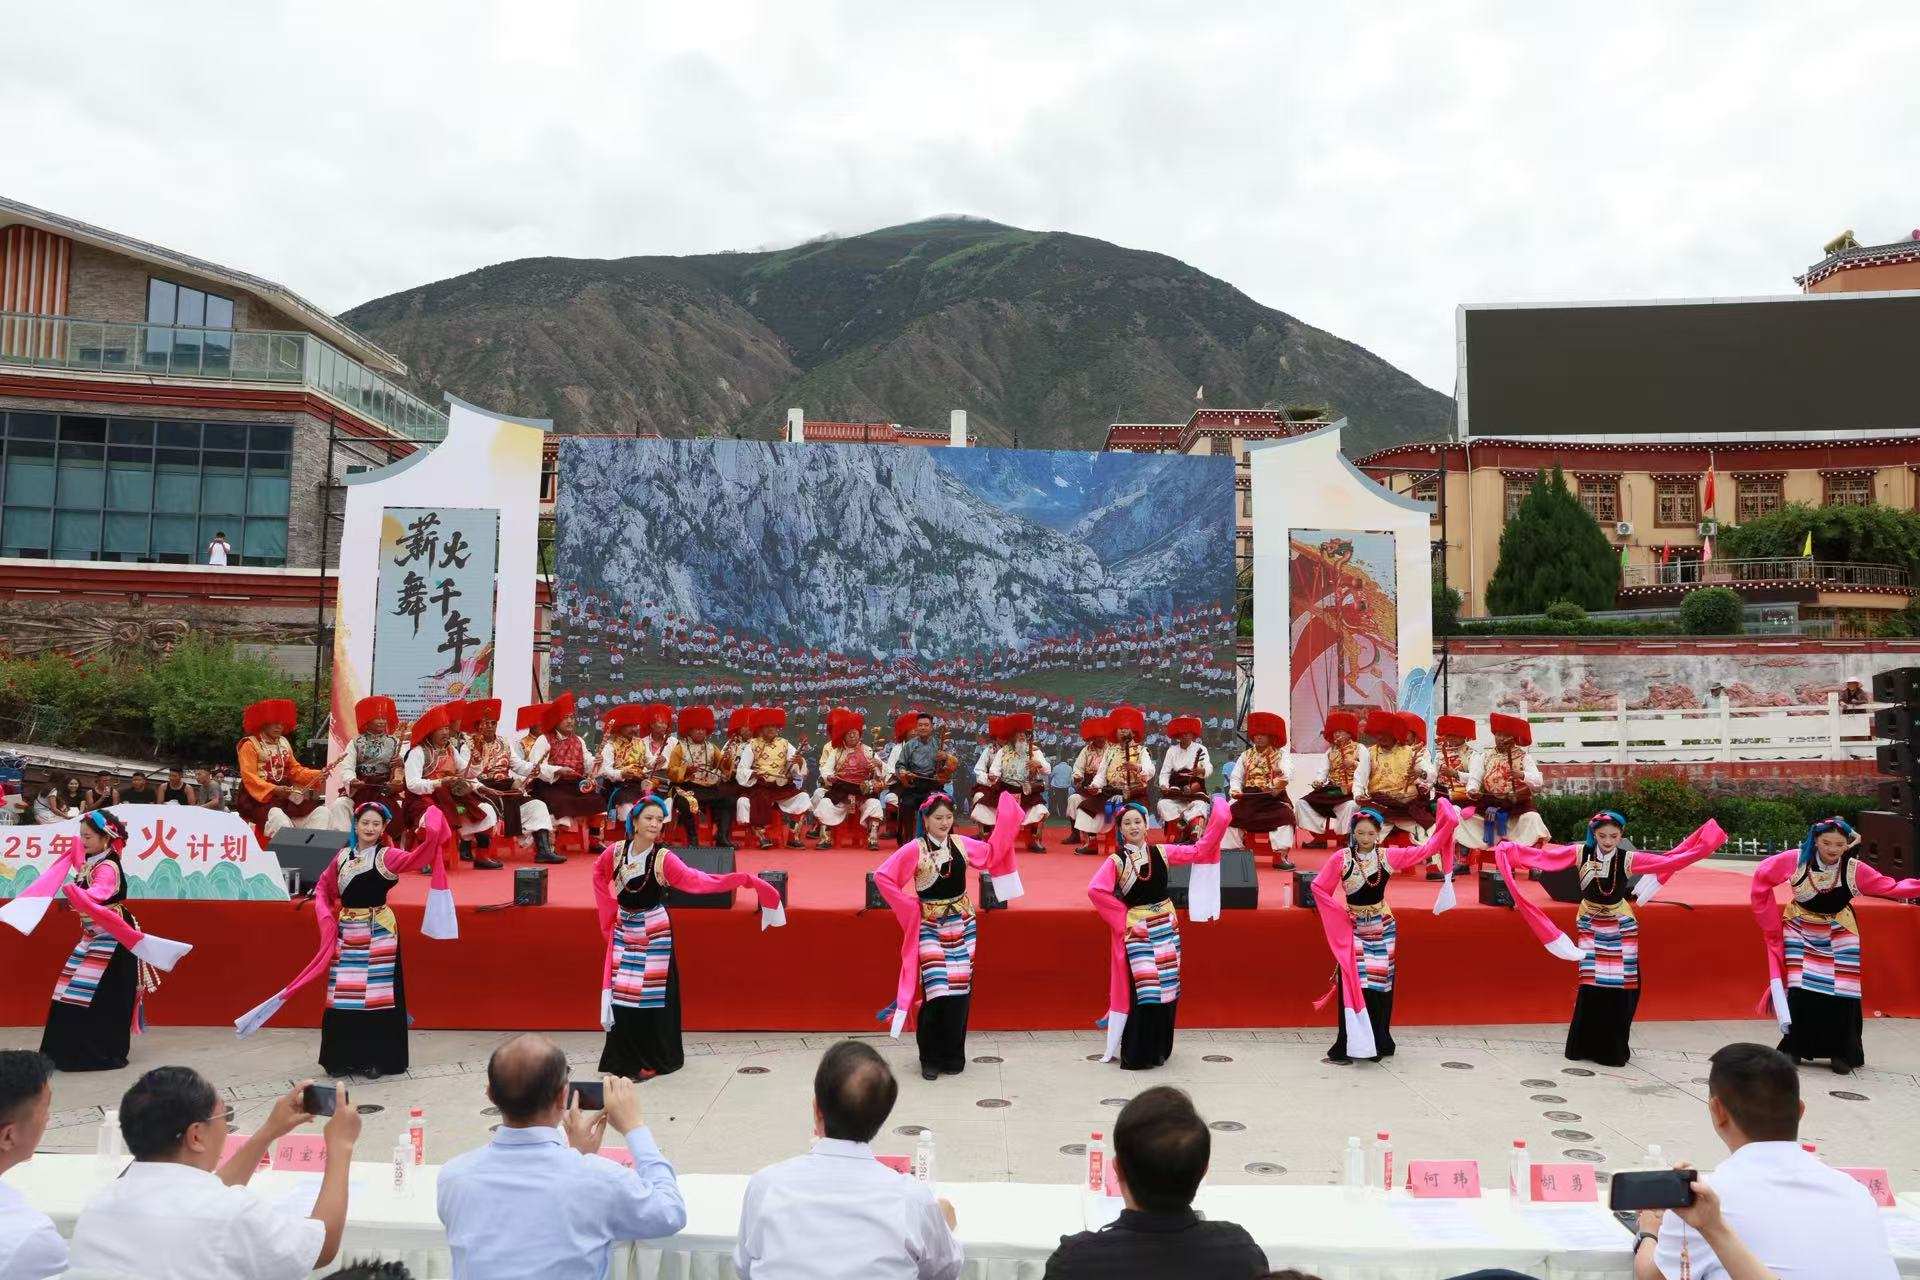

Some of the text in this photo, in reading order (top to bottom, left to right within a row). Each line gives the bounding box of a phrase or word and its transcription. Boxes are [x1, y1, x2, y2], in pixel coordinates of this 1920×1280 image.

[393, 511, 472, 577] 薪火
[388, 571, 482, 680] 舞千年
[4, 819, 248, 863] 25年火计划
